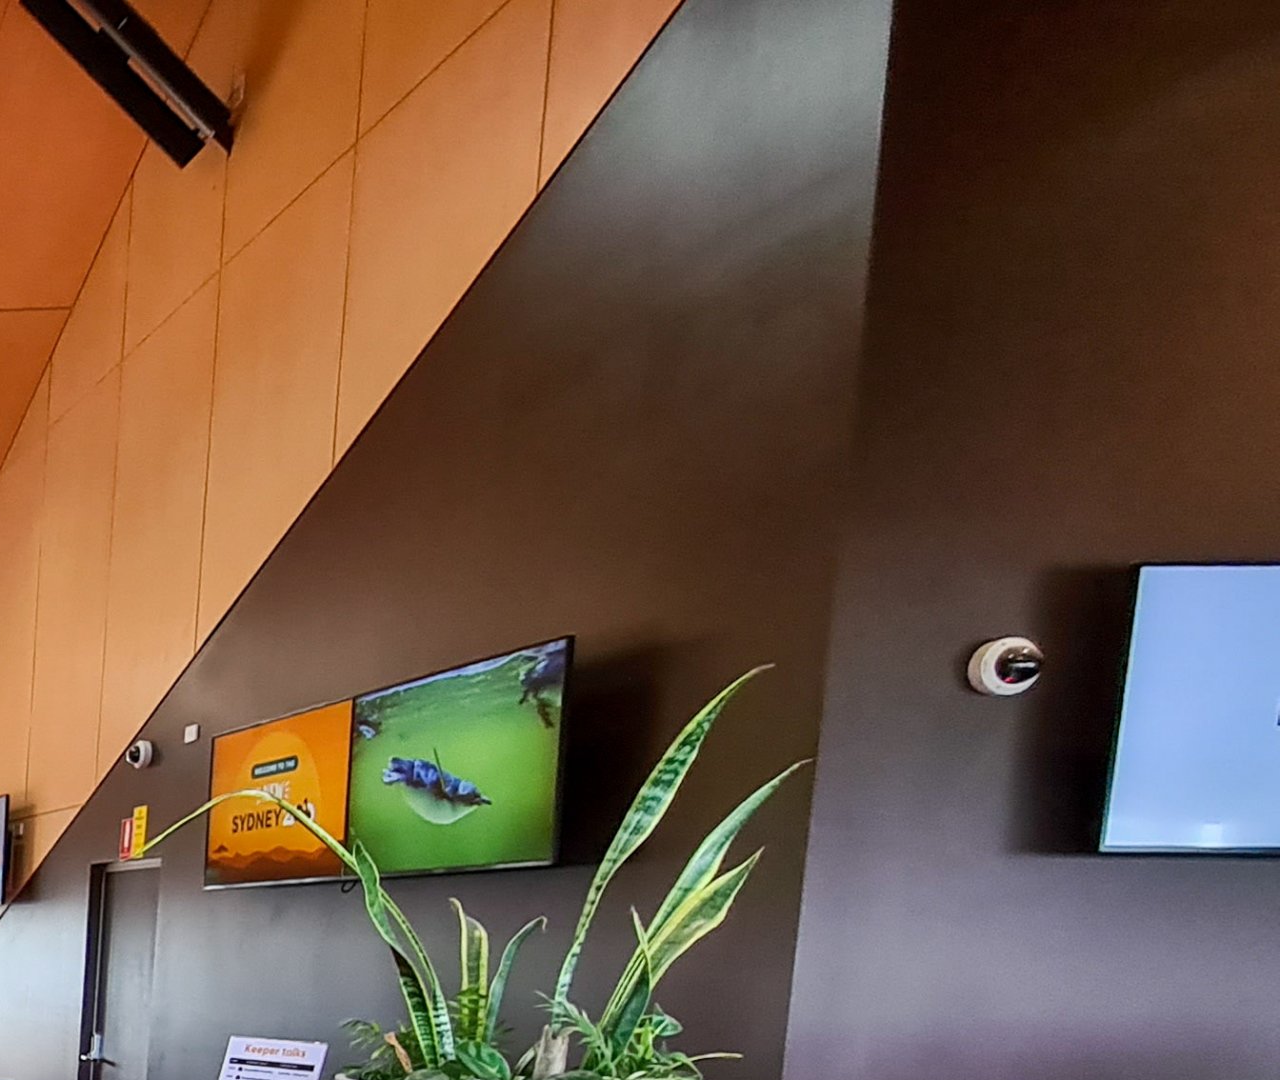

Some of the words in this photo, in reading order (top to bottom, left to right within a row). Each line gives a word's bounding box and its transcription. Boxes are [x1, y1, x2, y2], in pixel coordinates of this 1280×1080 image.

[232, 809, 282, 833] SYDNEY
[244, 1044, 279, 1057] Keeper
[282, 1047, 306, 1058] talks
